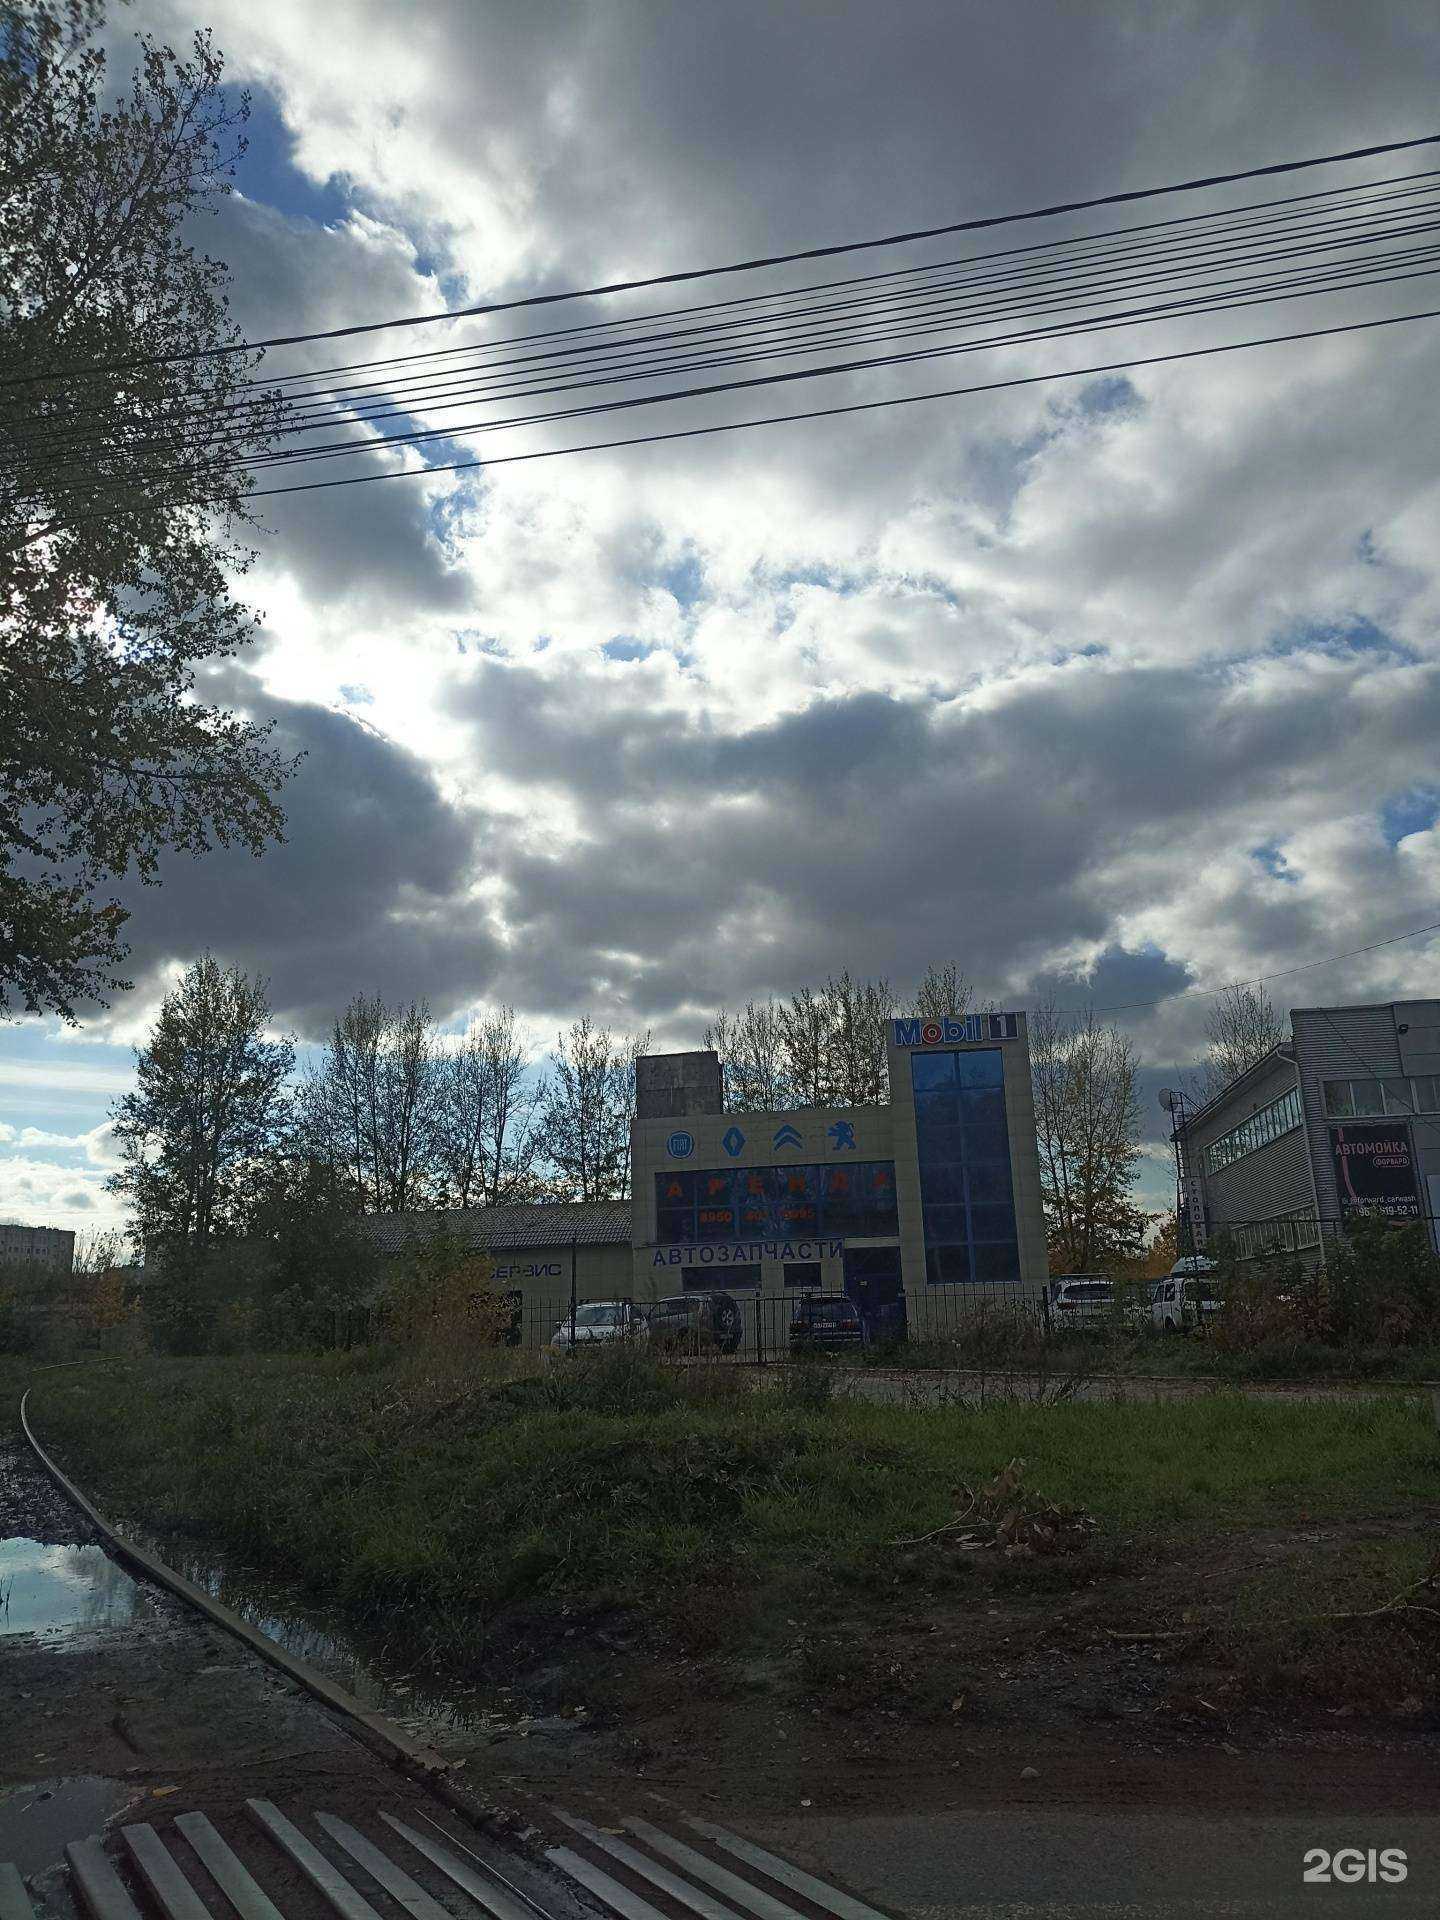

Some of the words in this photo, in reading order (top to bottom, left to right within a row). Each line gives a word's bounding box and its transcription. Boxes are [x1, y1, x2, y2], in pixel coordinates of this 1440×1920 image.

[894, 1015, 983, 1046] Mobil
[1335, 1139, 1408, 1155] АВТОМОЙКА
[653, 1241, 843, 1266] АВТОЗАПЧАСТИ
